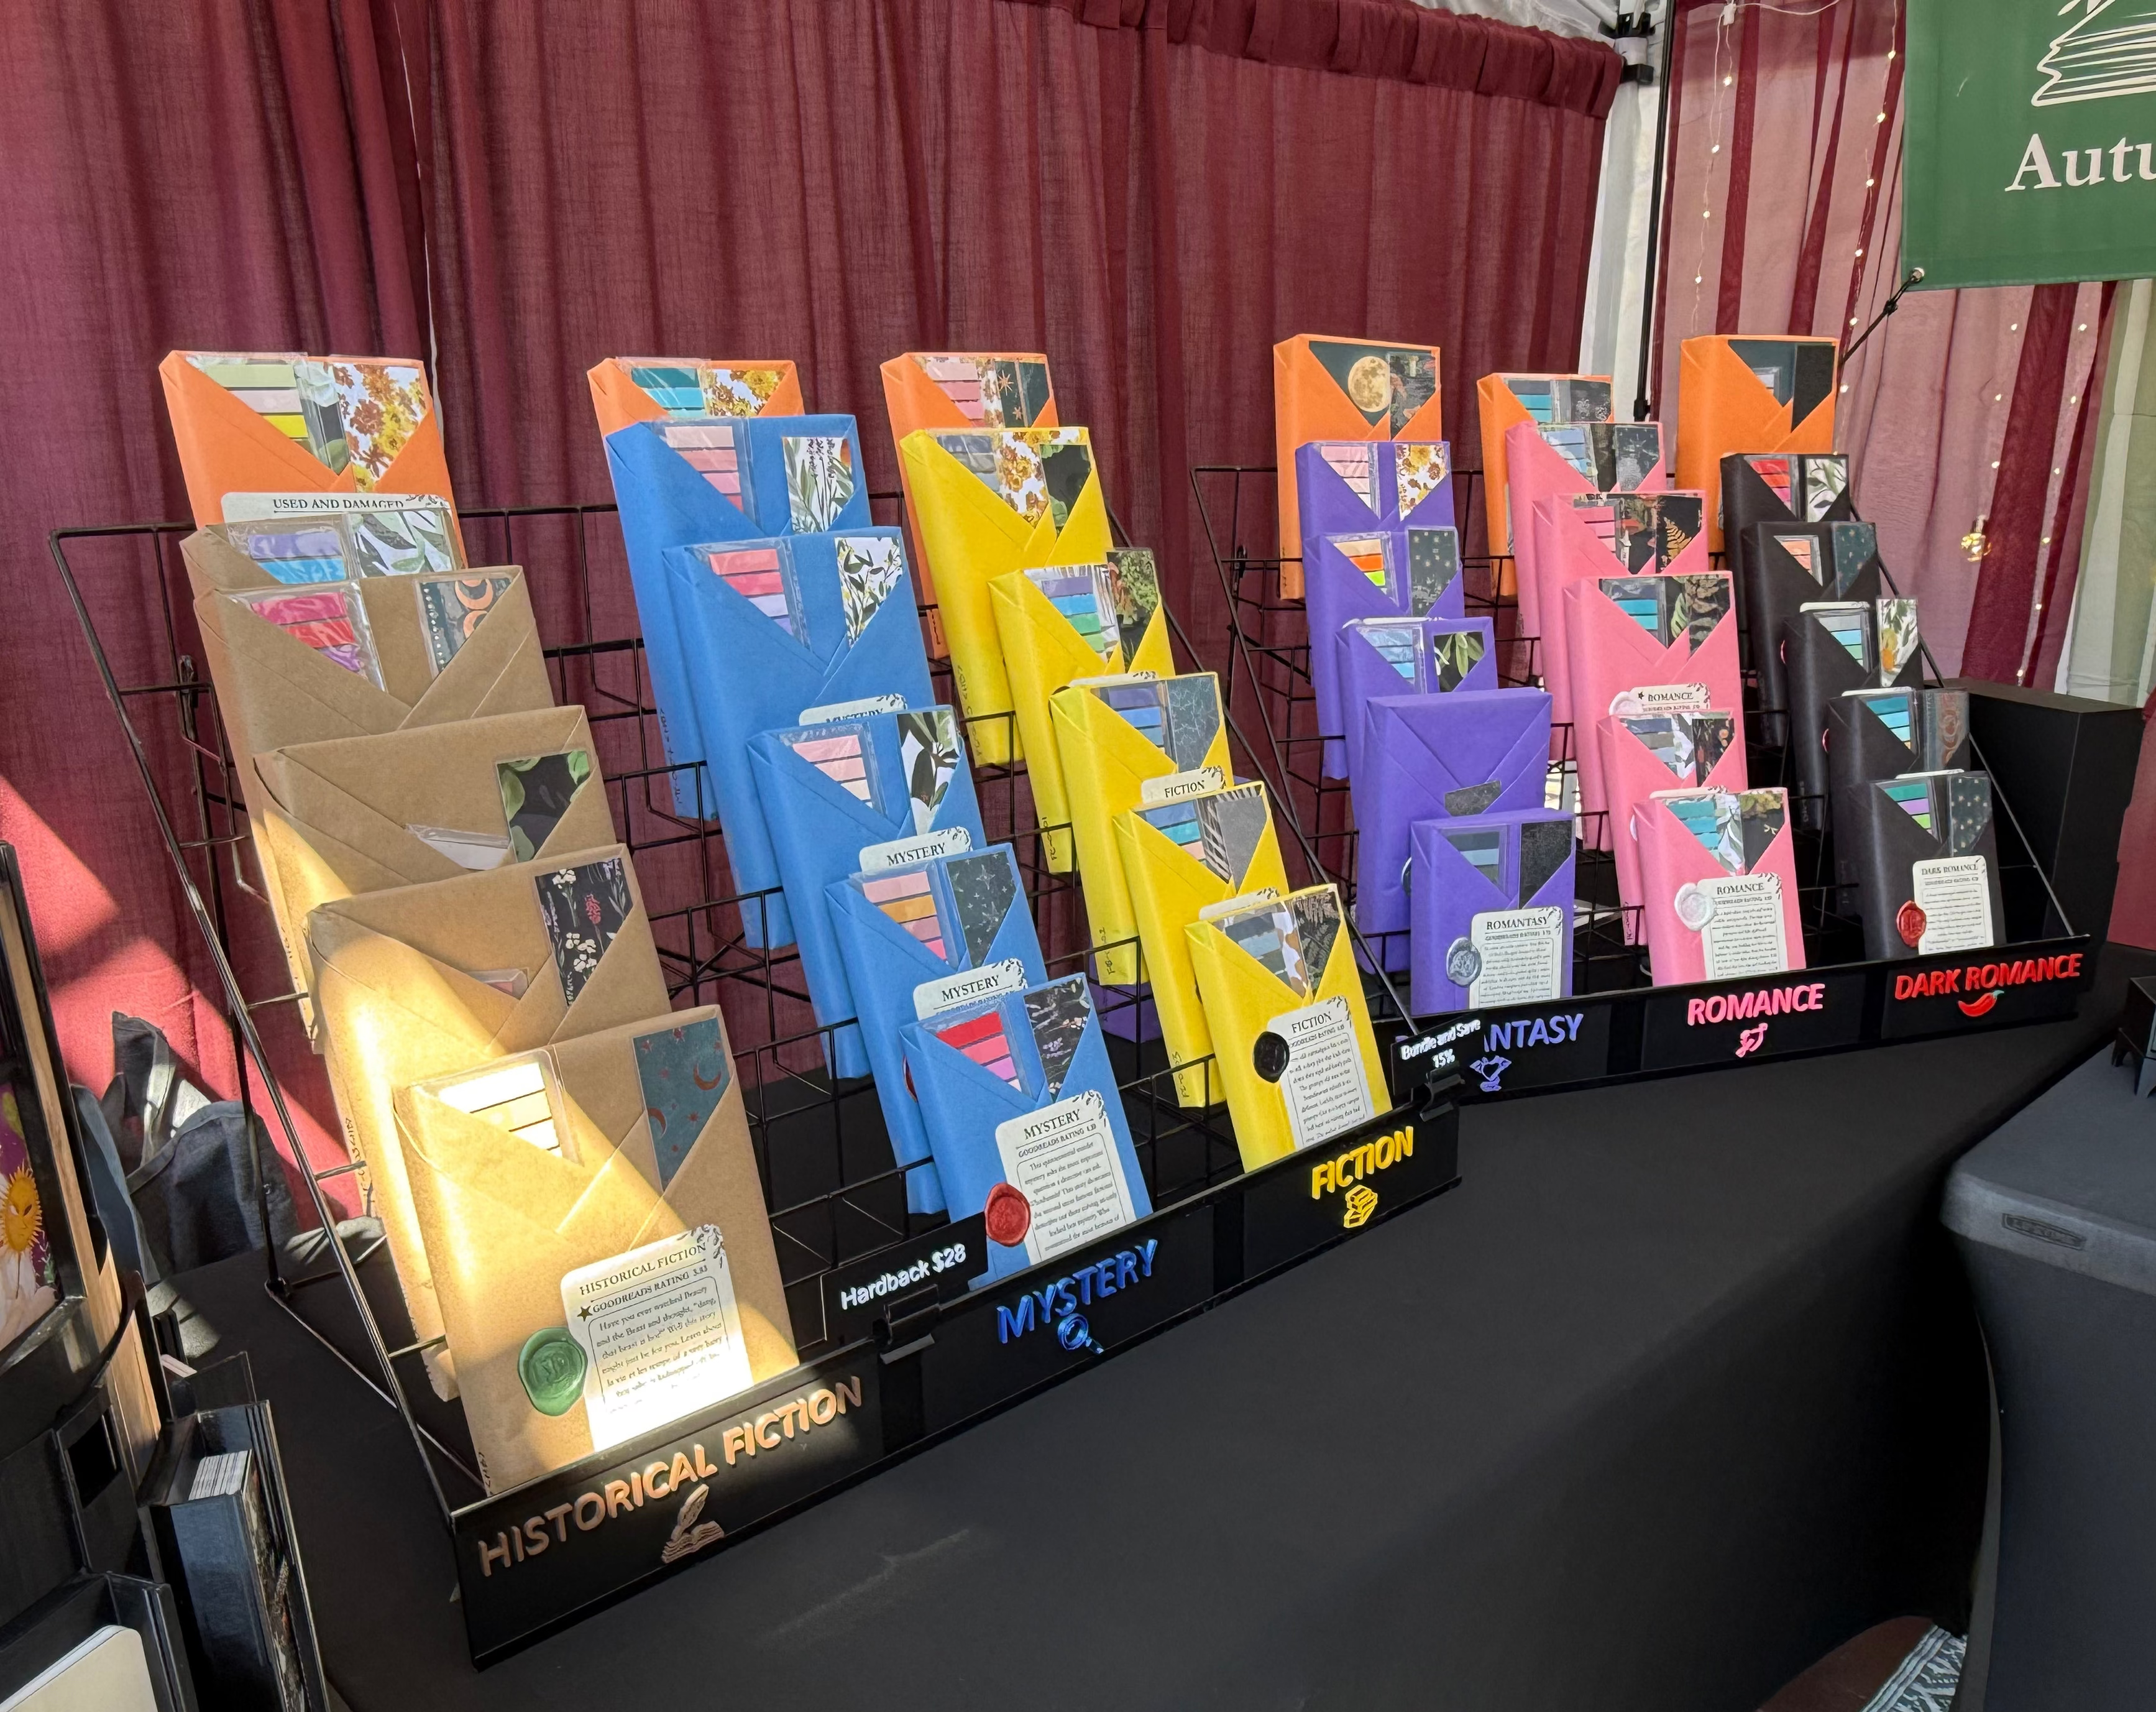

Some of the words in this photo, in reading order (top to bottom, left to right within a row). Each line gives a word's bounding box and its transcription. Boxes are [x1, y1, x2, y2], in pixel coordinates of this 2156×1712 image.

[273, 499, 307, 509] USED
[312, 499, 339, 509] AND
[1648, 692, 1694, 702] ROMANCE
[1165, 780, 1204, 798] FICTION
[887, 842, 945, 866] MYSTERY
[1922, 867, 1942, 876] DARK
[1943, 864, 1978, 873] ROMANCE
[1717, 883, 1764, 895] ROMANCE
[1487, 917, 1548, 931] ROMANTASY
[942, 975, 999, 1001] MYSTERY
[1895, 969, 1961, 1000] DARK
[1965, 954, 2083, 991] ROMANCE
[1687, 983, 1825, 1026] ROMANCE
[1291, 1011, 1332, 1033] FICTION
[1484, 1013, 1584, 1052] NTASY
[1400, 1036, 1438, 1061] Bundle
[1436, 1028, 1457, 1046] and
[1456, 1019, 1481, 1038] Save
[1432, 1049, 1456, 1068] 15%
[1023, 1108, 1081, 1139] MYSTERY
[1312, 1126, 1413, 1200] FICTION
[580, 1261, 655, 1296] HISTORICAL
[657, 1242, 707, 1268] FICTION
[840, 1259, 930, 1310] Hardback
[932, 1244, 966, 1273] $28
[592, 1285, 652, 1313] GOODREADS
[654, 1271, 689, 1291] RATING
[996, 1238, 1158, 1343] MYSTERY
[596, 1336, 610, 1346] and
[612, 1330, 624, 1341] the
[626, 1322, 645, 1335] Beast
[648, 1317, 661, 1327] and
[599, 1317, 619, 1332] Have
[622, 1314, 635, 1325] you
[681, 1330, 700, 1343] Learn
[478, 1443, 717, 1576] HISTORICAL
[723, 1376, 862, 1465] FICTION
